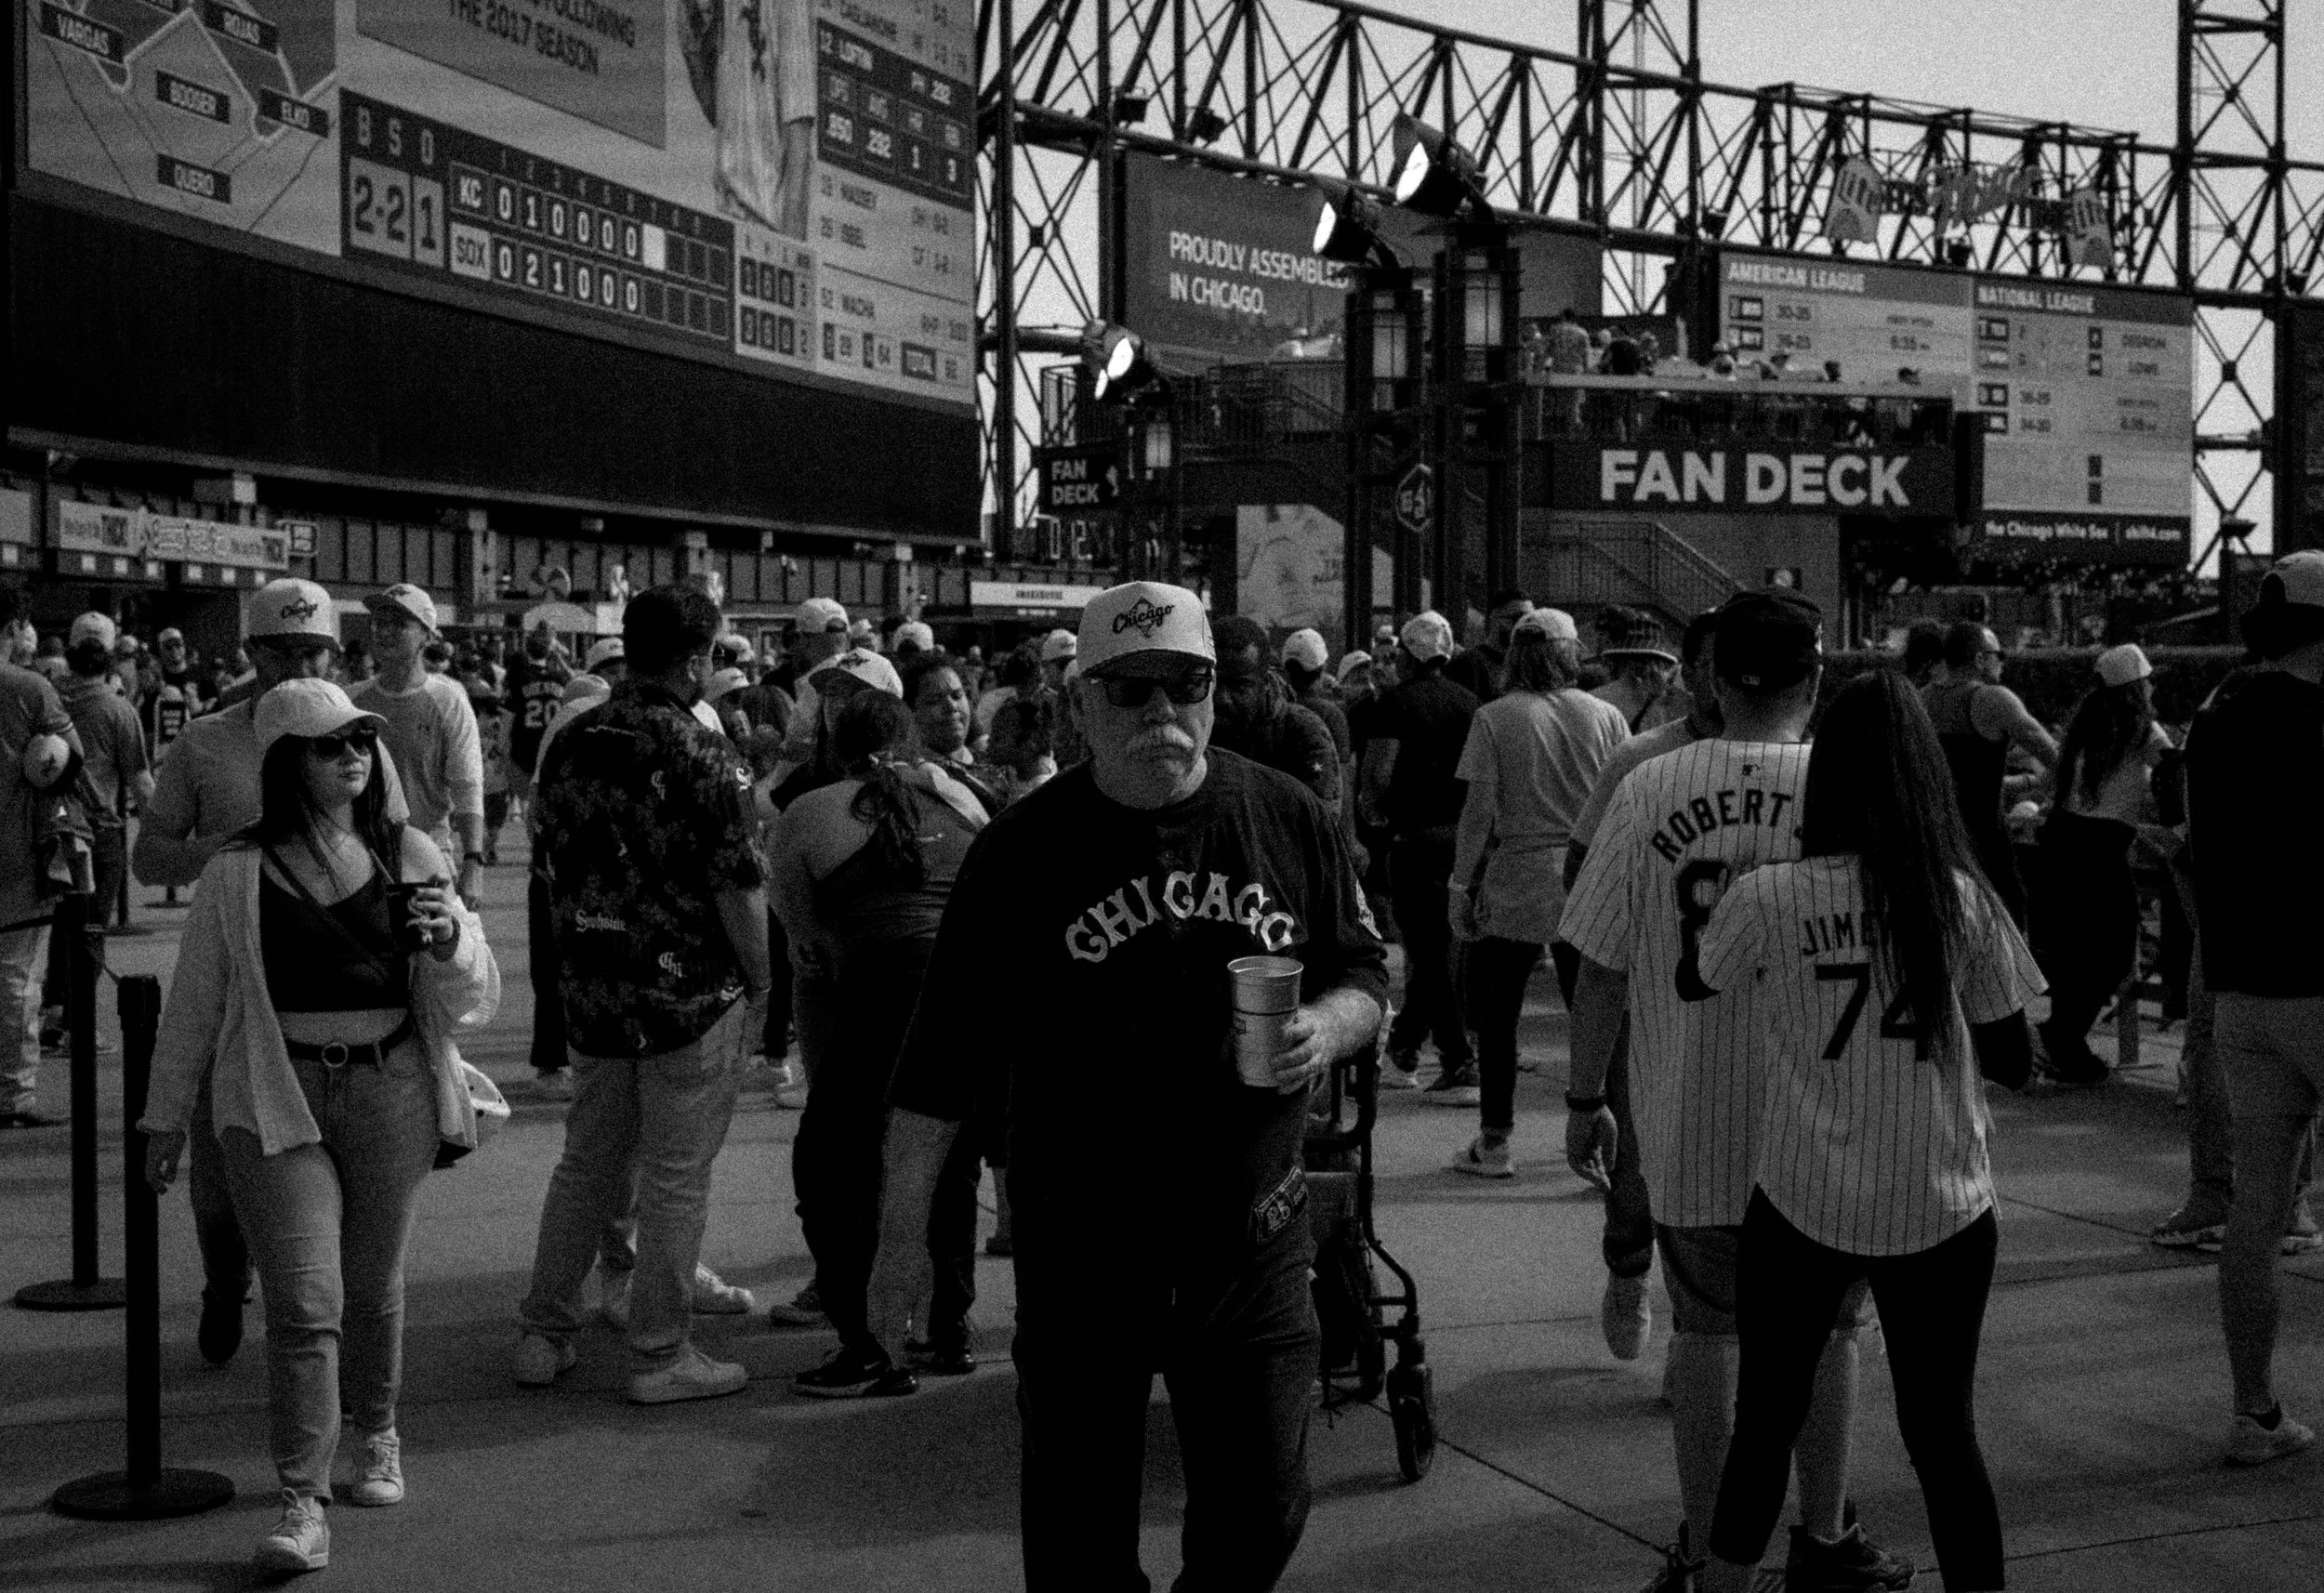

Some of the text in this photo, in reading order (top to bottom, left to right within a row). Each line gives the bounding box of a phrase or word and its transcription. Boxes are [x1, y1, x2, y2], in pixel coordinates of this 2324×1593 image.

[357, 105, 372, 148] B
[387, 117, 403, 157] S
[421, 195, 435, 250] 1
[458, 175, 638, 258] KC 0 1 0 0 0 0
[1169, 230, 1248, 273] PROUDLY
[456, 235, 638, 312] SOX 0 2 1 0 0 0
[1169, 272, 1268, 314] IN CHICAGO.
[1727, 262, 1866, 294] AMERICAN LEAGUE
[1978, 285, 2094, 314] NATIONAL LEAGUE
[1051, 458, 1088, 481] FAN
[1601, 449, 1911, 507] FAN DECK
[1051, 482, 1100, 507] DECK
[2006, 520, 2054, 542] Chicago
[2088, 522, 2109, 539] Sox
[1112, 604, 1175, 635] Chicago
[524, 699, 563, 730] 20
[1651, 788, 1792, 863] ROBERT
[1064, 870, 1295, 964] CHICAGO
[1815, 962, 1931, 1061] 74
